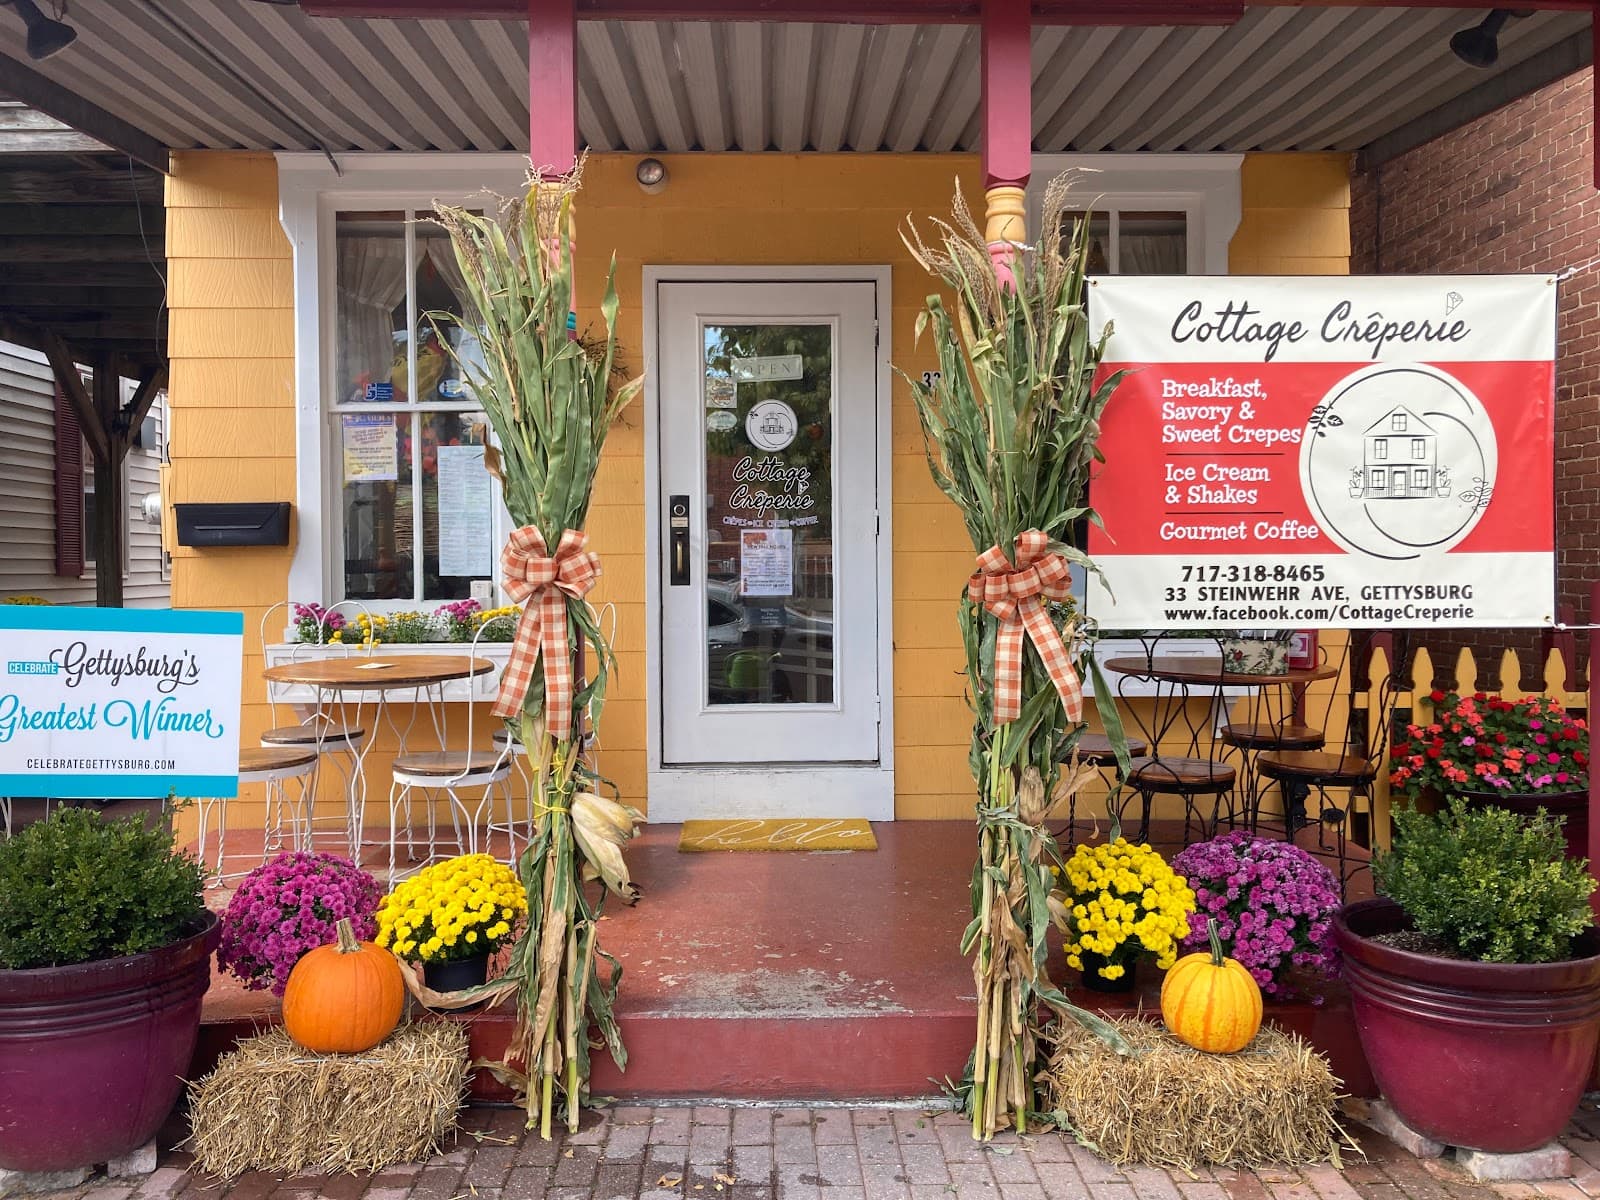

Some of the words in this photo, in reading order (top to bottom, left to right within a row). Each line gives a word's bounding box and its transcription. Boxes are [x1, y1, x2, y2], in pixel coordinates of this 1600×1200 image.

[1171, 300, 1307, 362] Cottage
[1321, 300, 1471, 359] Crêperie
[743, 362, 792, 375] OPEN
[1162, 378, 1267, 401] Breakfast,
[1162, 403, 1231, 425] Savory
[1239, 404, 1254, 420] &
[1162, 425, 1221, 443] Sweet
[1227, 426, 1301, 448] Crepes
[733, 456, 811, 492] Cottage
[1166, 464, 1196, 482] Ice
[1202, 464, 1270, 482] Cream
[729, 484, 815, 518] Crêperie
[1165, 487, 1181, 504] &
[1188, 486, 1257, 504] Shakes
[1160, 522, 1246, 542] Gourmet
[1254, 522, 1318, 541] Coffee
[1182, 565, 1325, 582] 717-318-8465
[1165, 588, 1187, 601] 33
[1198, 586, 1299, 601] STEINWEHR
[1311, 586, 1349, 602] AVE,
[1361, 585, 1473, 600] GETTYSBURG
[1165, 604, 1474, 621] www.facebook.com/CottageCreperie
[10, 663, 56, 673] CELEBRATE
[49, 641, 200, 693] Gettysburg's
[0, 695, 96, 742] Greatest
[104, 697, 223, 740] Winner
[27, 759, 175, 770] CELEBRATEGETTYSBURG.COM
[684, 820, 872, 845] hello
